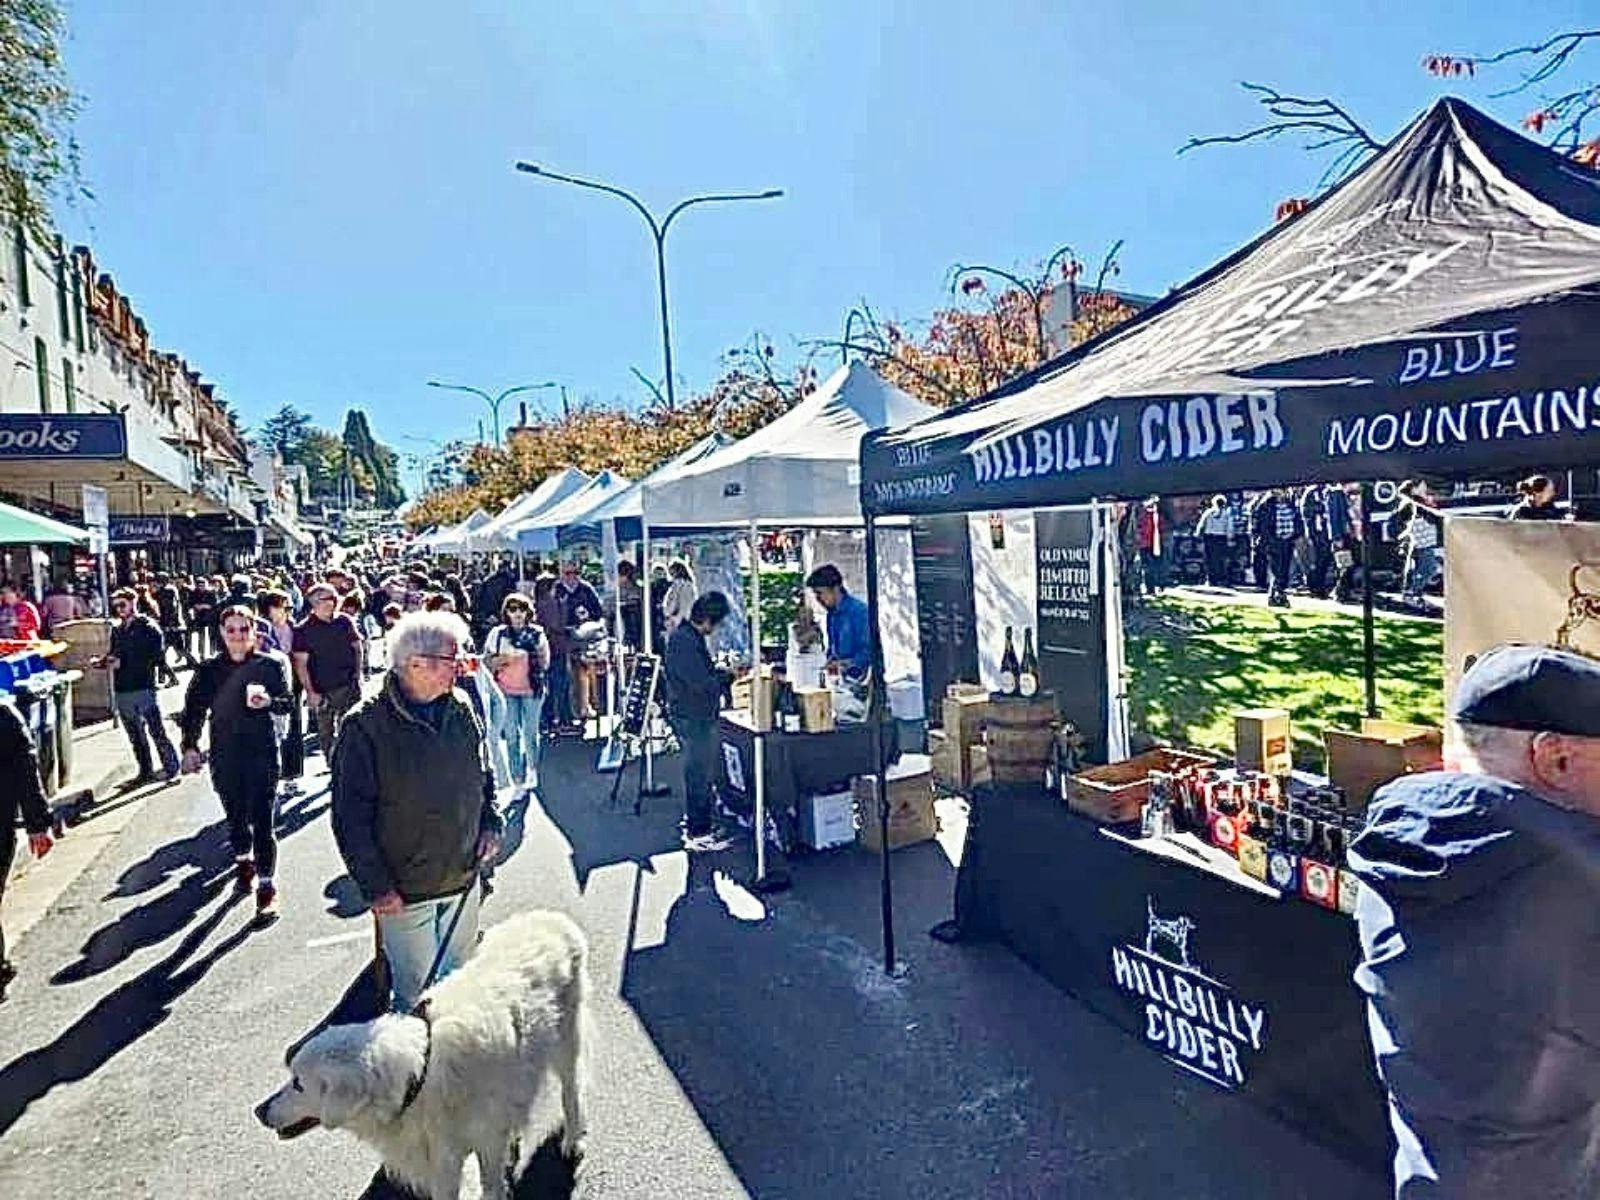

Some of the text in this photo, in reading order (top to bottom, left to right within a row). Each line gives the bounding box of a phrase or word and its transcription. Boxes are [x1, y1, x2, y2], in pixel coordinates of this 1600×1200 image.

[1400, 328, 1517, 382] BLUE
[972, 392, 1284, 482] HILLBILLY CIDER
[1112, 946, 1263, 1049] HILLBILLY
[1146, 1004, 1244, 1083] CIDER
